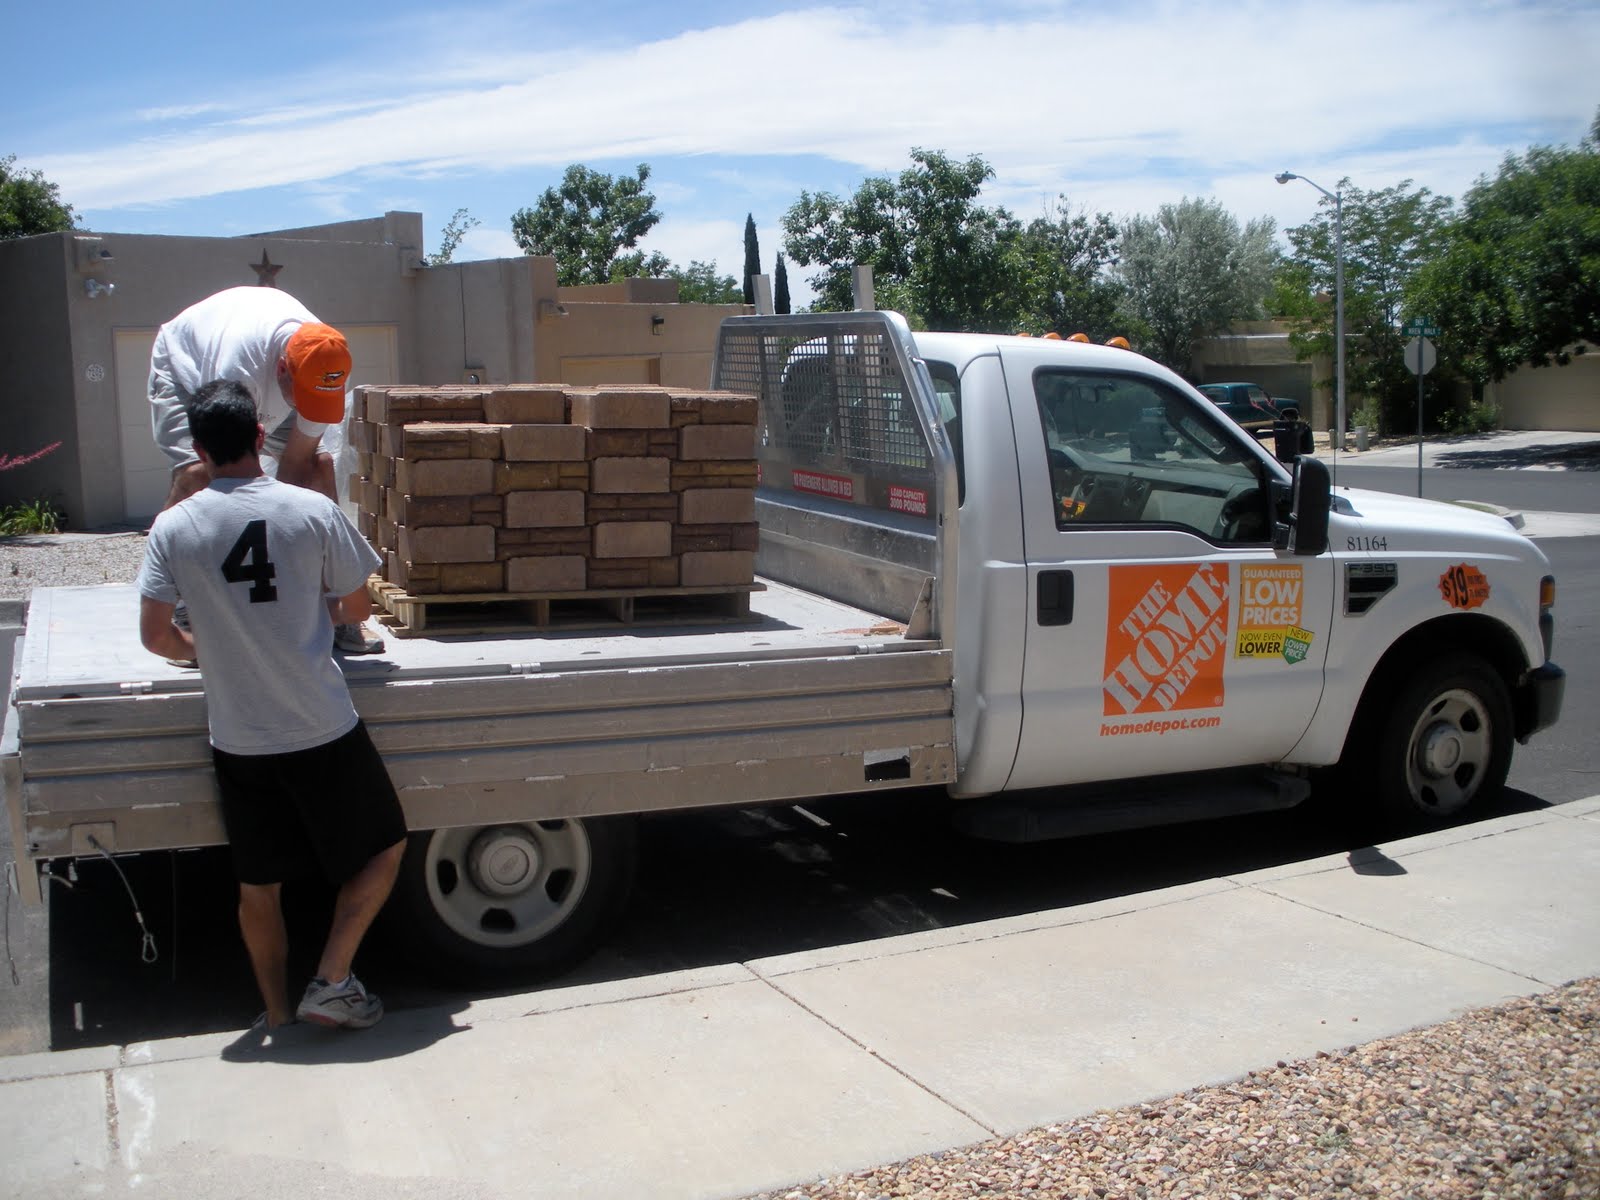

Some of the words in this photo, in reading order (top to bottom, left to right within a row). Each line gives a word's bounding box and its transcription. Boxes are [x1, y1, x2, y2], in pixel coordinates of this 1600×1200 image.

[800, 473, 821, 491] PASSENGERS
[821, 477, 839, 494] ALLOWED
[843, 481, 852, 497] BED
[890, 487, 902, 498] LOAD
[902, 489, 924, 502] CAPACITY
[890, 497, 902, 508] 3000
[903, 499, 926, 514] POUNDS
[1347, 536, 1387, 551] 81164
[221, 519, 278, 603] 4
[1243, 569, 1301, 578] GUARANTEED
[1244, 580, 1301, 605] LOW
[1442, 566, 1469, 606] $19
[1118, 579, 1172, 641] THE
[1242, 607, 1298, 625] PRICES
[1102, 562, 1229, 714] HOME
[1240, 632, 1262, 641] NOW
[1263, 633, 1282, 641] EVEN
[1290, 628, 1309, 640] NEW
[1284, 647, 1303, 660] PRICE
[1285, 639, 1308, 652] LOWER
[1152, 616, 1228, 711] DEPOT
[1100, 716, 1220, 736] homedepot.com
